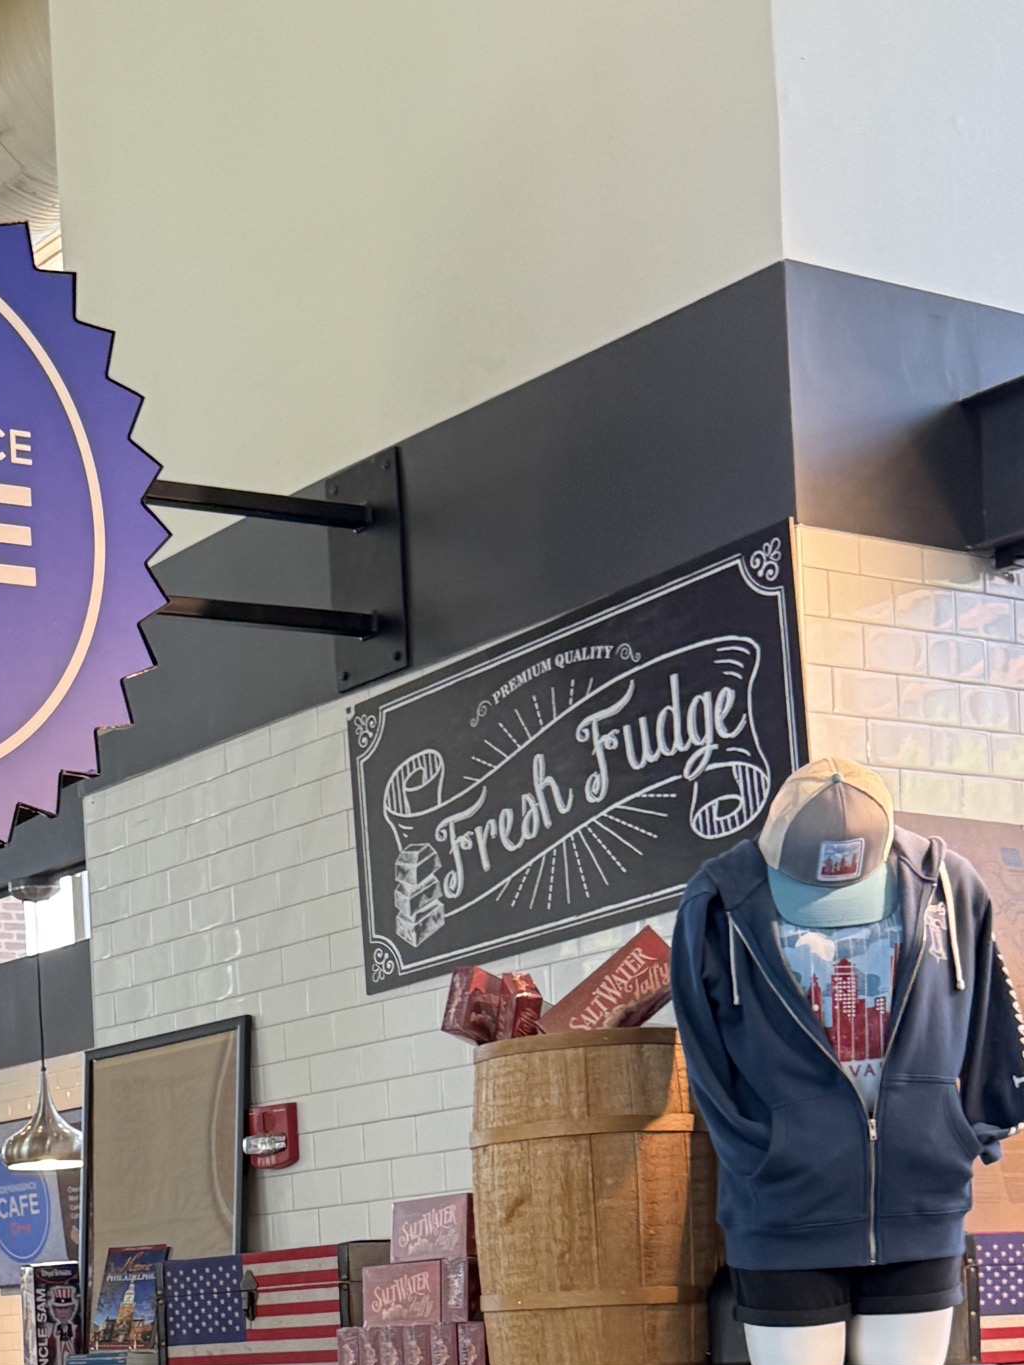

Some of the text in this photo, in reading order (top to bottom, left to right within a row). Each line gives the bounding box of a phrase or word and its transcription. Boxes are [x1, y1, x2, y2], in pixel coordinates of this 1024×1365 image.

[491, 645, 615, 705] PREMIUM QUALITY
[434, 673, 748, 899] Fresh Fudge
[257, 1155, 277, 1167] FIRE
[36, 1288, 48, 1323] SAM
